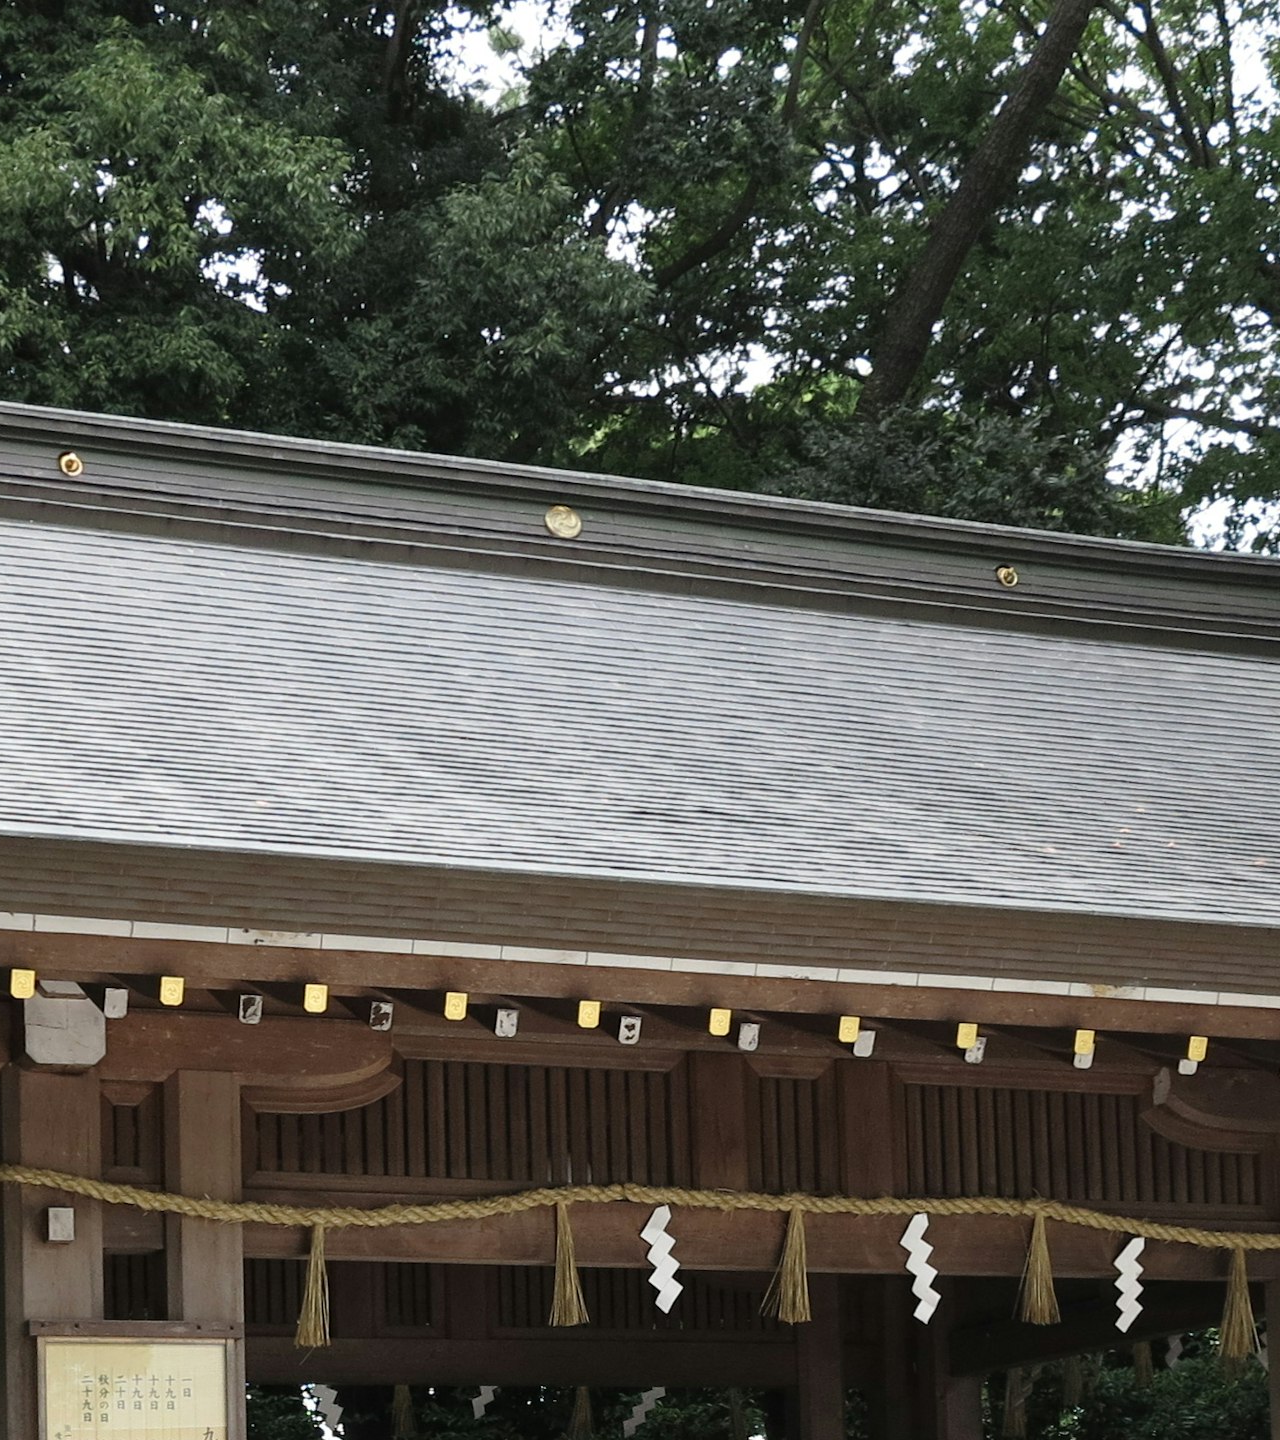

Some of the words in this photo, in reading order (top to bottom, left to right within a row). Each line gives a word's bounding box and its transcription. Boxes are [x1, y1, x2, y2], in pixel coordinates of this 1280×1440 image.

[81, 1375, 94, 1423] 二十九日
[98, 1374, 109, 1423] 秋分の日
[115, 1376, 127, 1411] 二十日
[132, 1374, 144, 1411] 十九日
[148, 1375, 160, 1411] 十九日
[165, 1375, 177, 1411] 十九日
[181, 1377, 193, 1398] 一日
